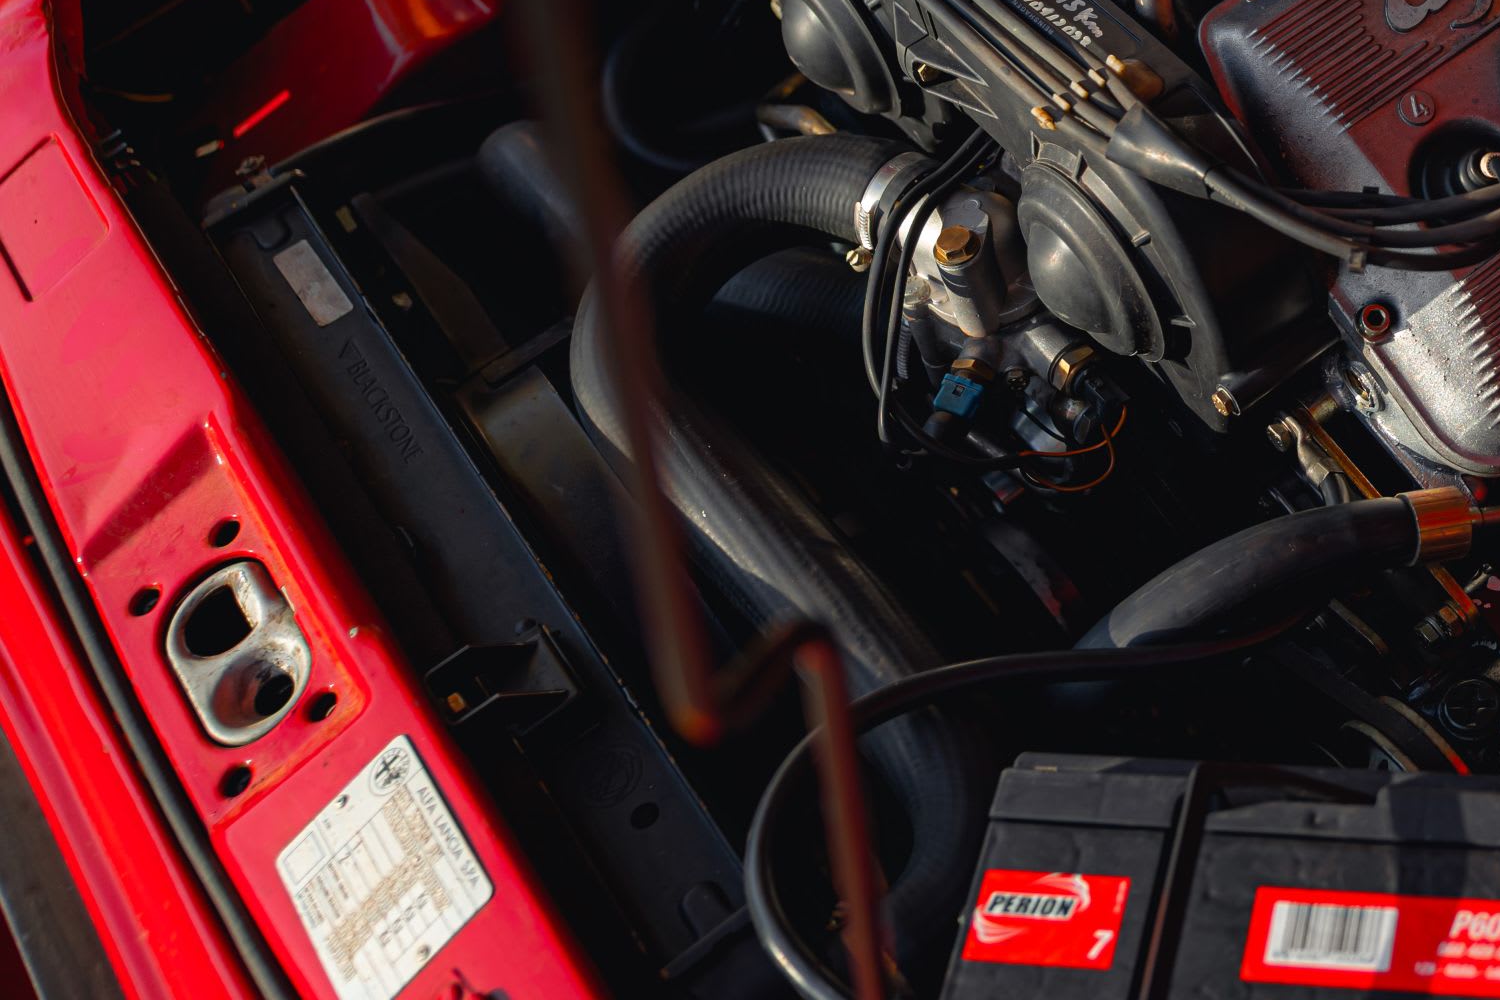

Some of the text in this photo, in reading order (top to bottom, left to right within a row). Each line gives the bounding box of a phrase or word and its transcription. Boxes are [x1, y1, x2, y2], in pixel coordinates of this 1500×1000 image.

[346, 358, 425, 465] BLACKSTONE
[417, 786, 437, 816] ALFA
[433, 814, 464, 860] LANCIA
[987, 894, 1076, 918] PERION
[1086, 930, 1114, 960] 7
